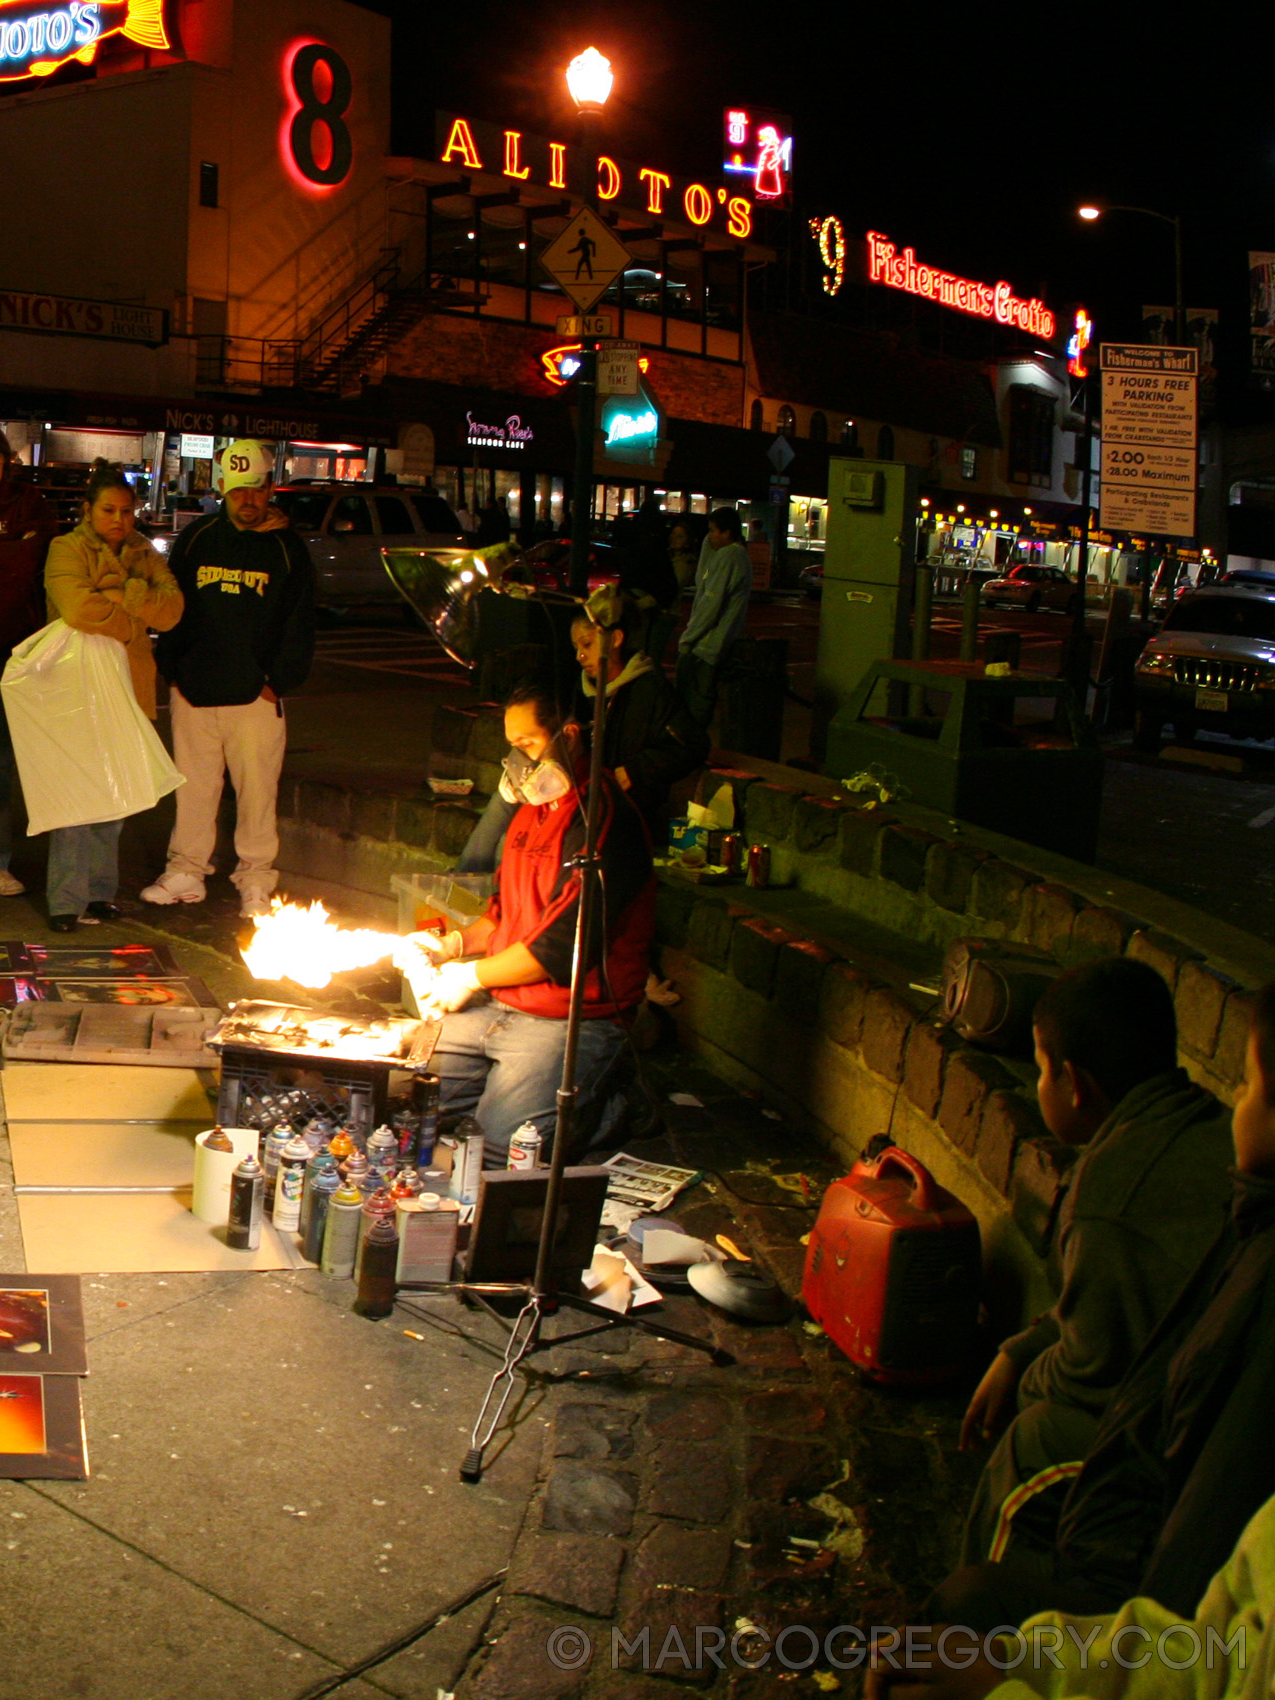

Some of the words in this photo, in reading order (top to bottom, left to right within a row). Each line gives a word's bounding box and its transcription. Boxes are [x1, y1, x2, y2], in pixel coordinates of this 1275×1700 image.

[291, 44, 352, 186] 8
[442, 119, 753, 238] ALIOTO'S
[867, 231, 993, 317] Fishermen's
[995, 281, 1054, 339] Grotto
[112, 307, 153, 323] LIGHT
[111, 321, 155, 338] HOUSE
[563, 318, 604, 333] XING
[1107, 348, 1160, 368] Fisherman's
[1163, 353, 1191, 369] Wharf
[610, 365, 627, 373] ANY
[608, 376, 627, 385] TIME
[1107, 376, 1114, 386] 3
[1119, 377, 1159, 388] HOURS
[1164, 380, 1190, 391] FREE
[1123, 390, 1175, 402] PARKING
[1105, 409, 1149, 417] PARTICIPATING
[165, 409, 215, 431] NICK'S
[245, 416, 320, 439] LIGHTHOUSE
[467, 437, 503, 447] SEAFOOD
[506, 441, 524, 449] CAFE
[230, 455, 250, 473] SD
[1106, 450, 1145, 464] $2.00
[1142, 470, 1190, 482] Maximum
[1106, 488, 1148, 498] Participating
[1150, 492, 1189, 501] Restaurants
